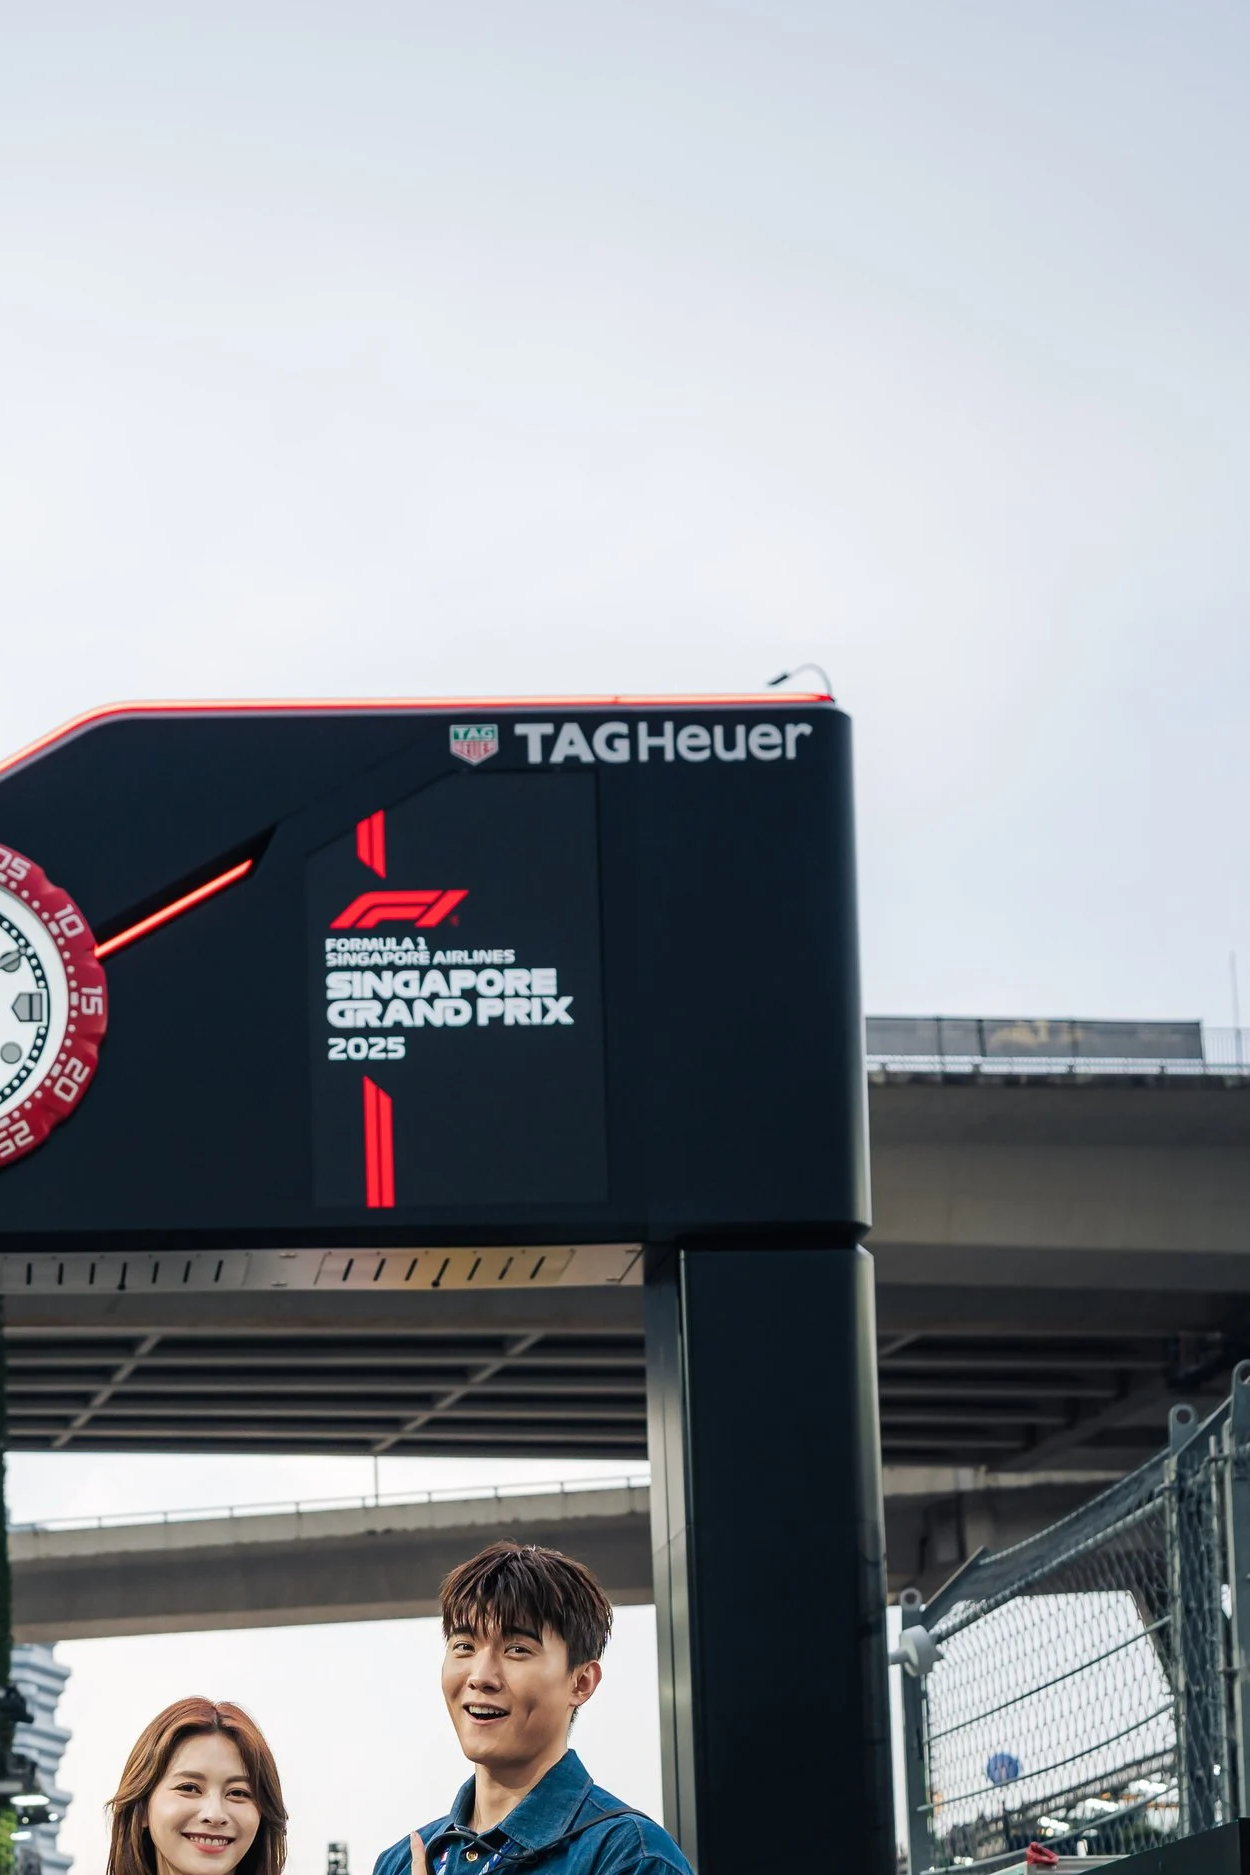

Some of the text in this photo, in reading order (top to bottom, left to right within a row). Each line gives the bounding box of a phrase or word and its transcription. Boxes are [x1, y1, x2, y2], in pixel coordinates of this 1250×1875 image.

[454, 727, 494, 741] TAG
[54, 904, 84, 938] 10
[325, 937, 428, 953] FORMULA 1
[325, 949, 516, 968] SINGAPORE AIRLINES
[326, 968, 557, 999] SINGAPORE
[81, 985, 103, 1016] 15
[326, 996, 575, 1028] GRAND PRIX
[327, 1036, 406, 1061] 2025
[54, 1060, 90, 1102] 20
